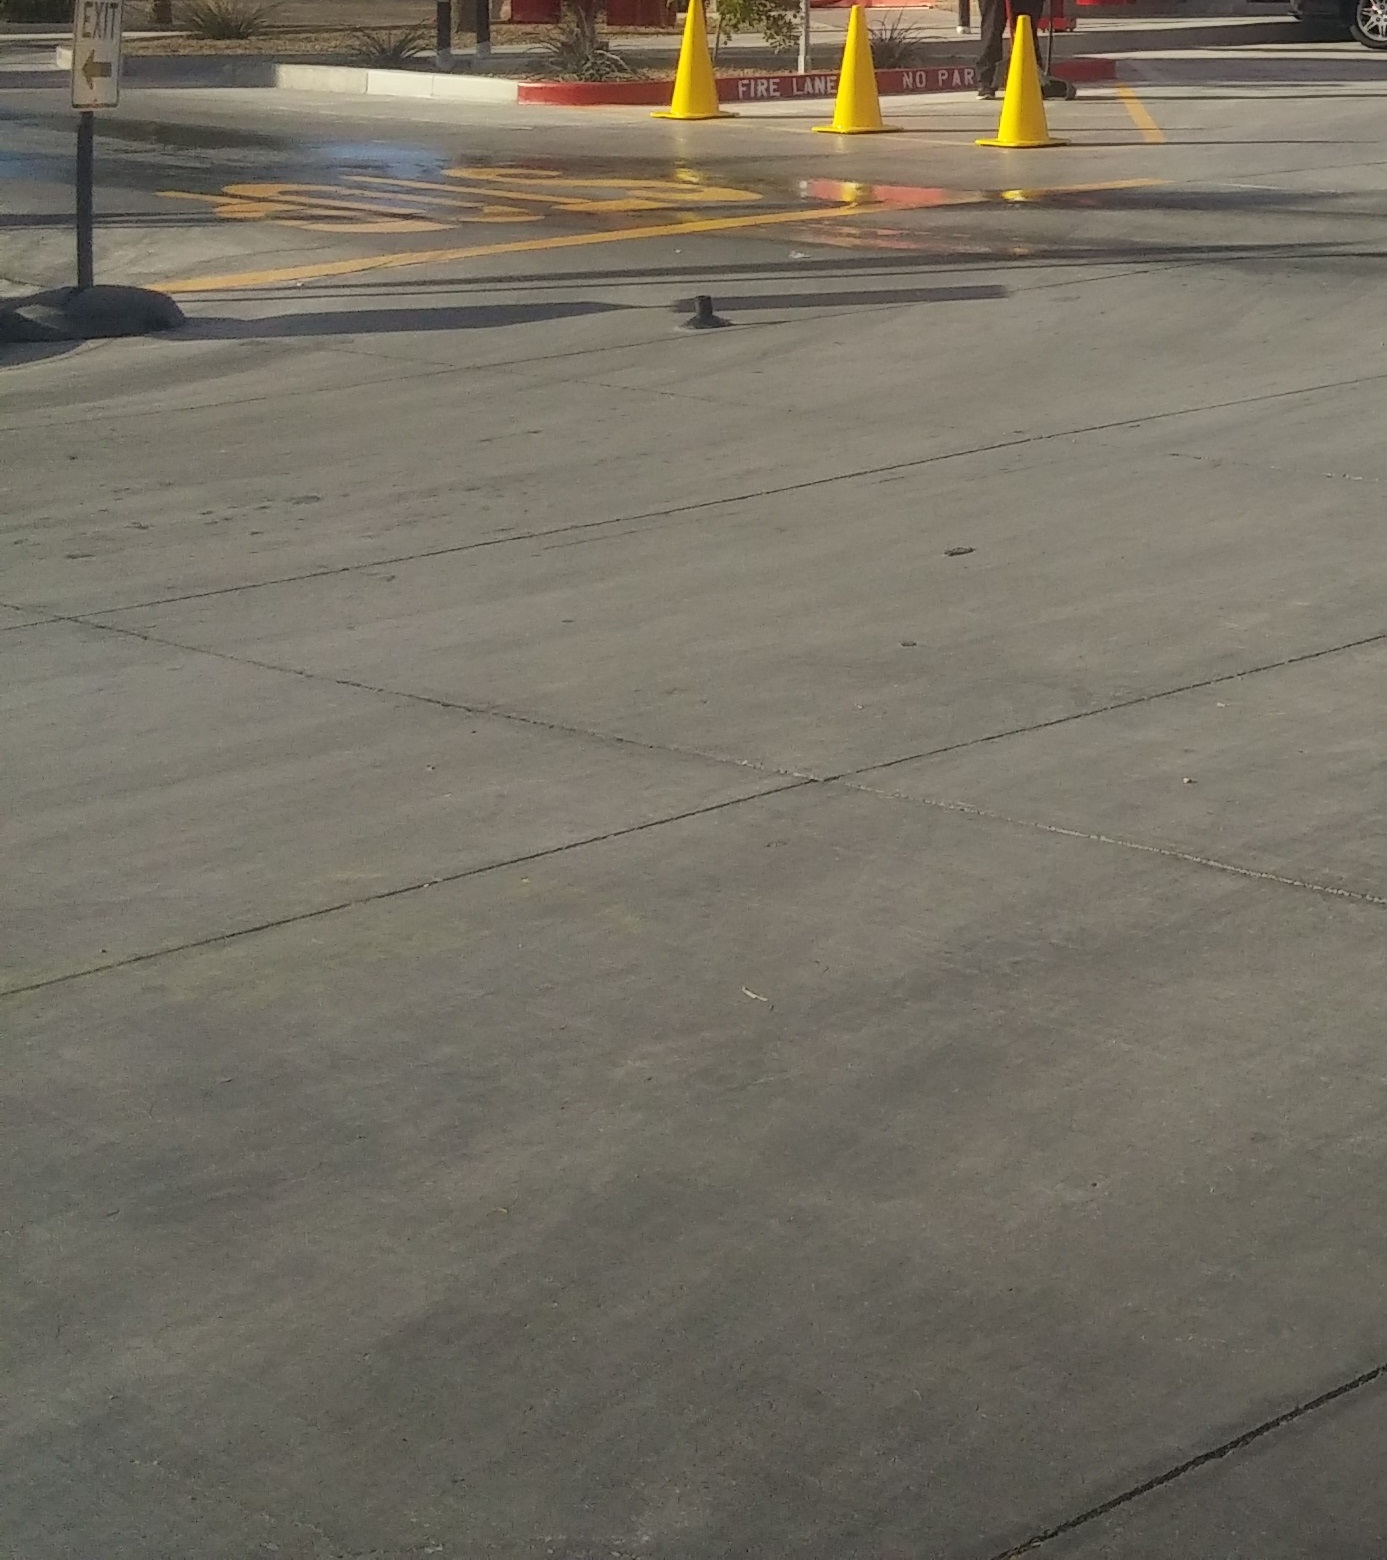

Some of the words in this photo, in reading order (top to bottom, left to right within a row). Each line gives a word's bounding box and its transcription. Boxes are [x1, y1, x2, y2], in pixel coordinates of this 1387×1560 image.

[82, 1, 119, 39] EXIT
[737, 78, 781, 99] FIRE
[792, 75, 838, 95] LANE
[902, 70, 927, 89] NO
